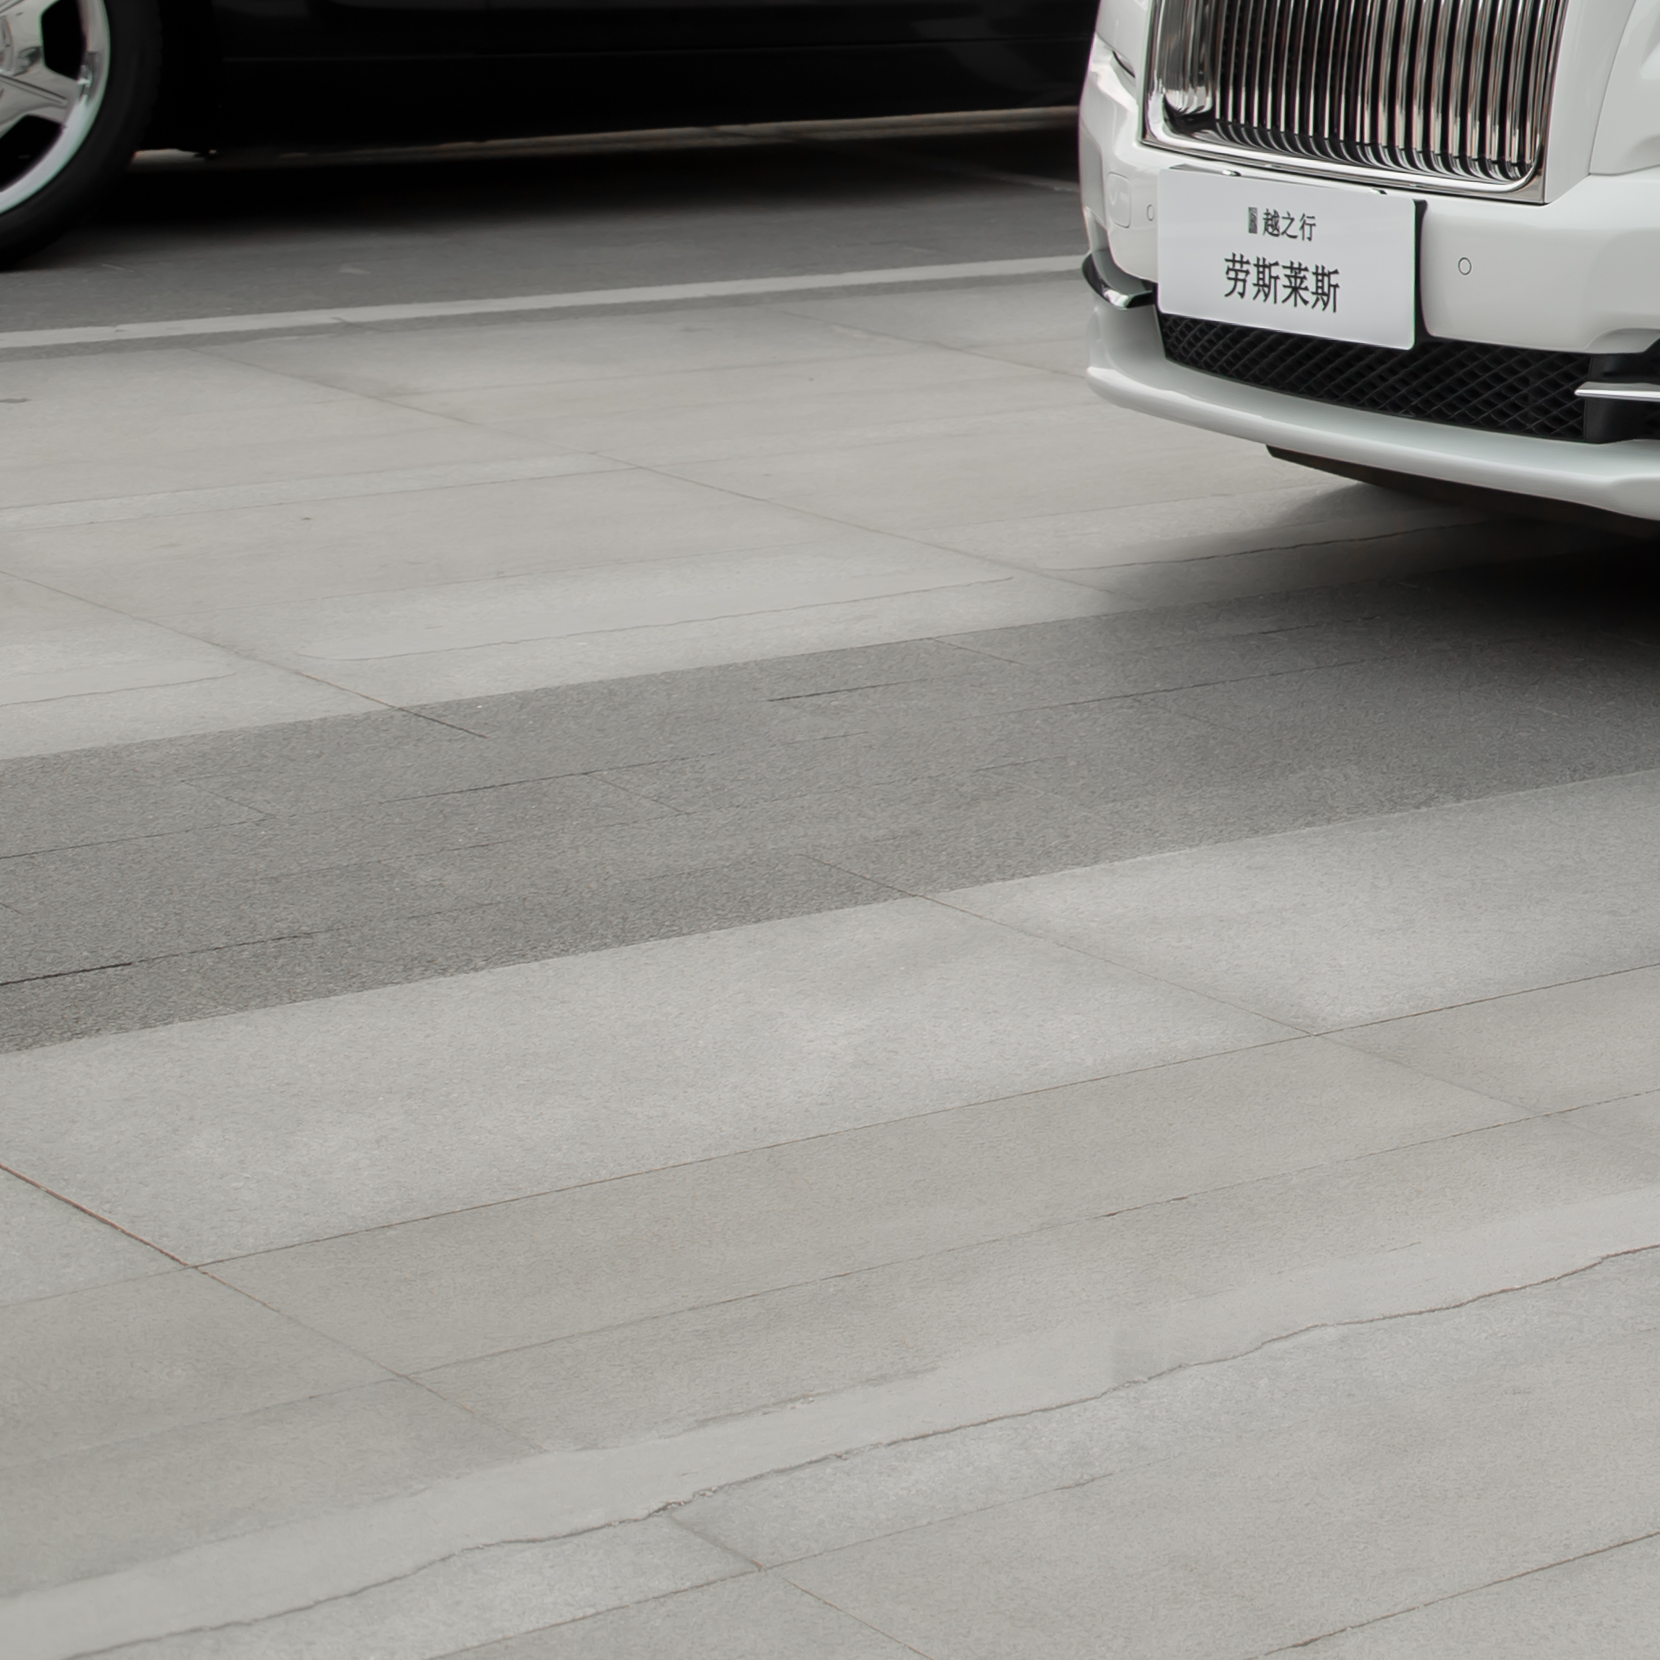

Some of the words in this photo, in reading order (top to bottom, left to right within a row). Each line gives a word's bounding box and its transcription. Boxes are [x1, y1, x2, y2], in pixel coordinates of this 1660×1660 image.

[1262, 208, 1317, 242] 越之行
[1224, 252, 1341, 313] 劳斯莱斯
